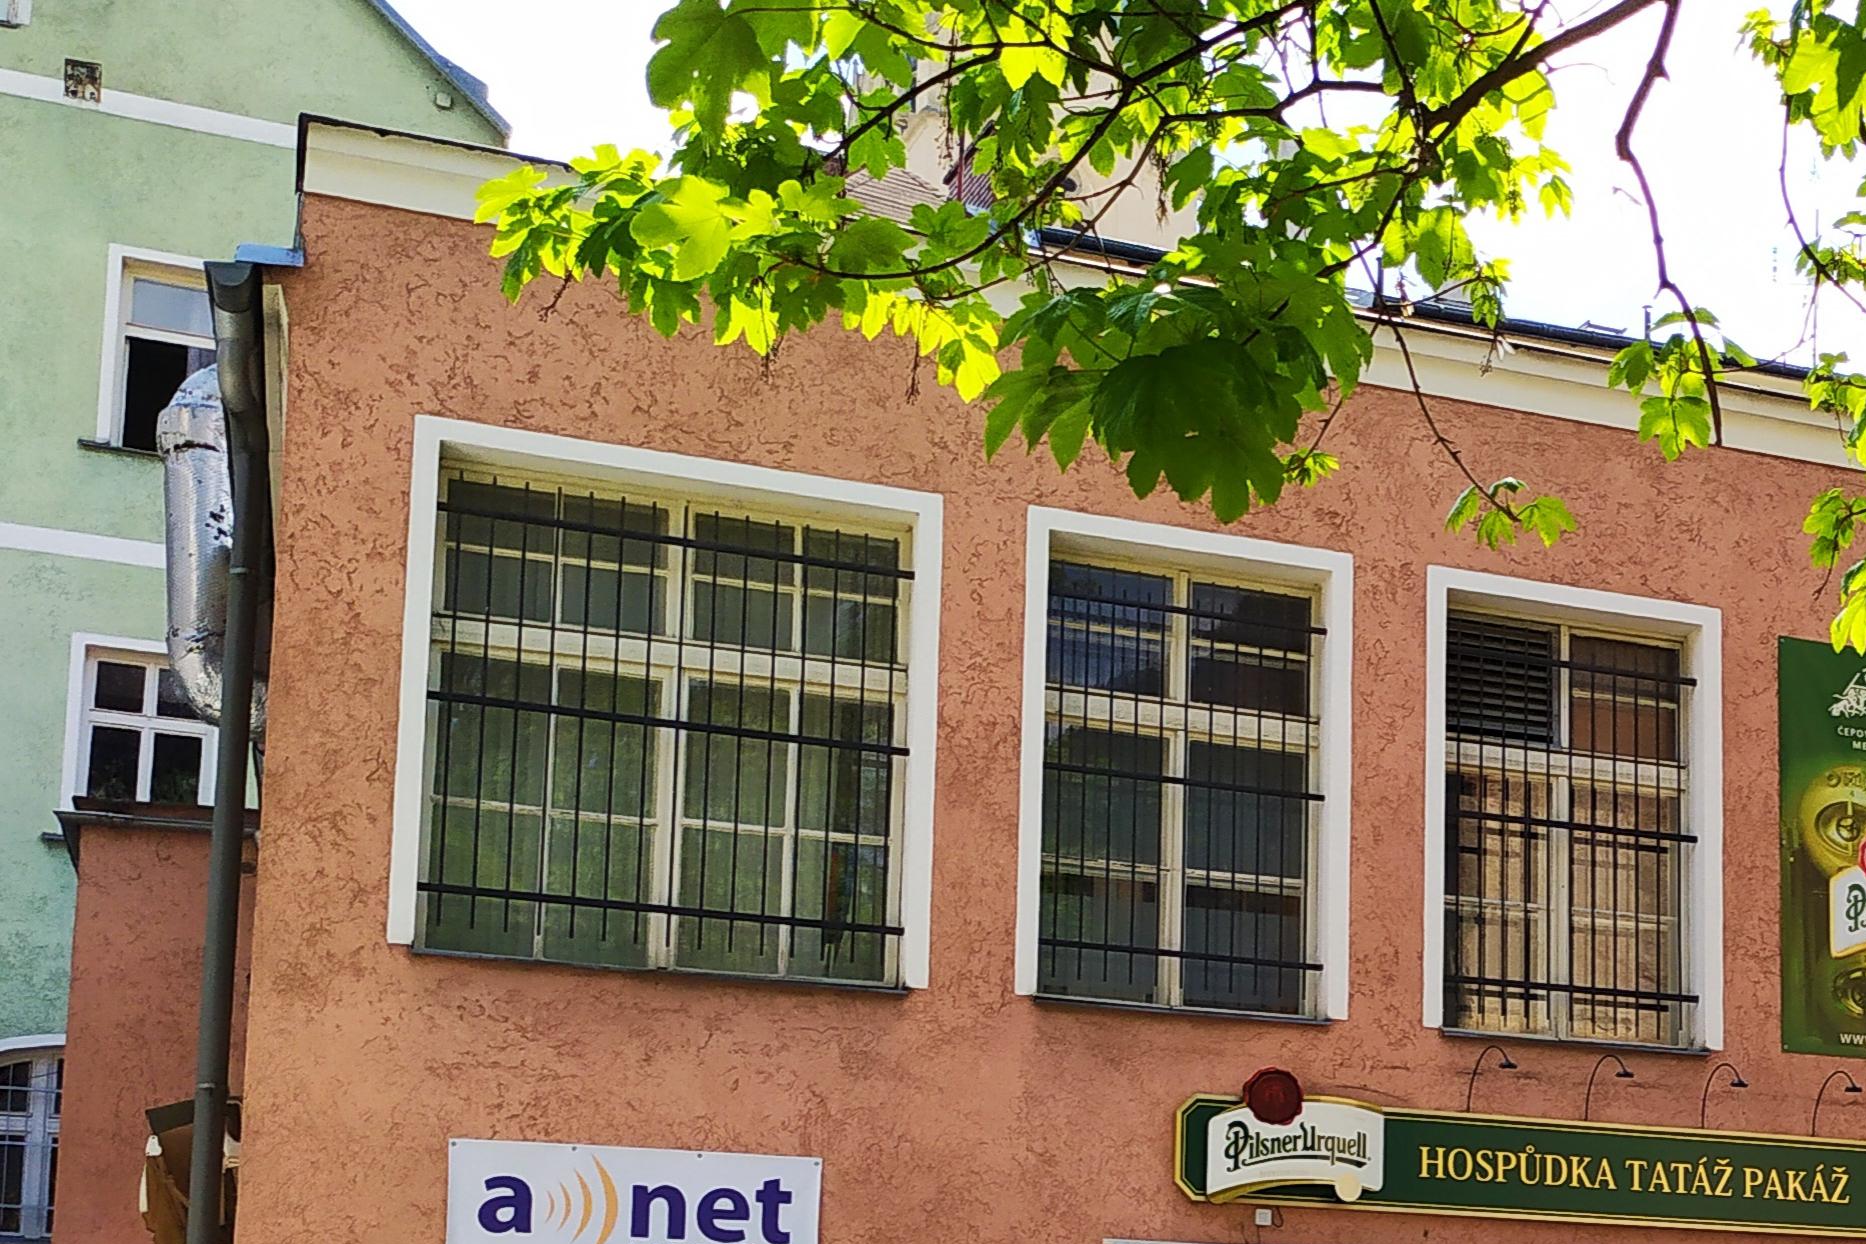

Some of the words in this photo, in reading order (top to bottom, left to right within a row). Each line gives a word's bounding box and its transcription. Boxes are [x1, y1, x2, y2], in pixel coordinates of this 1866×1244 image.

[1224, 1121, 1302, 1172] Pilsner
[1300, 1122, 1366, 1165] Urquell
[1418, 1145, 1617, 1190] HOSPŮDKA
[1625, 1157, 1734, 1198] TATÁŽ
[1742, 1165, 1850, 1204] PAKÁŽ
